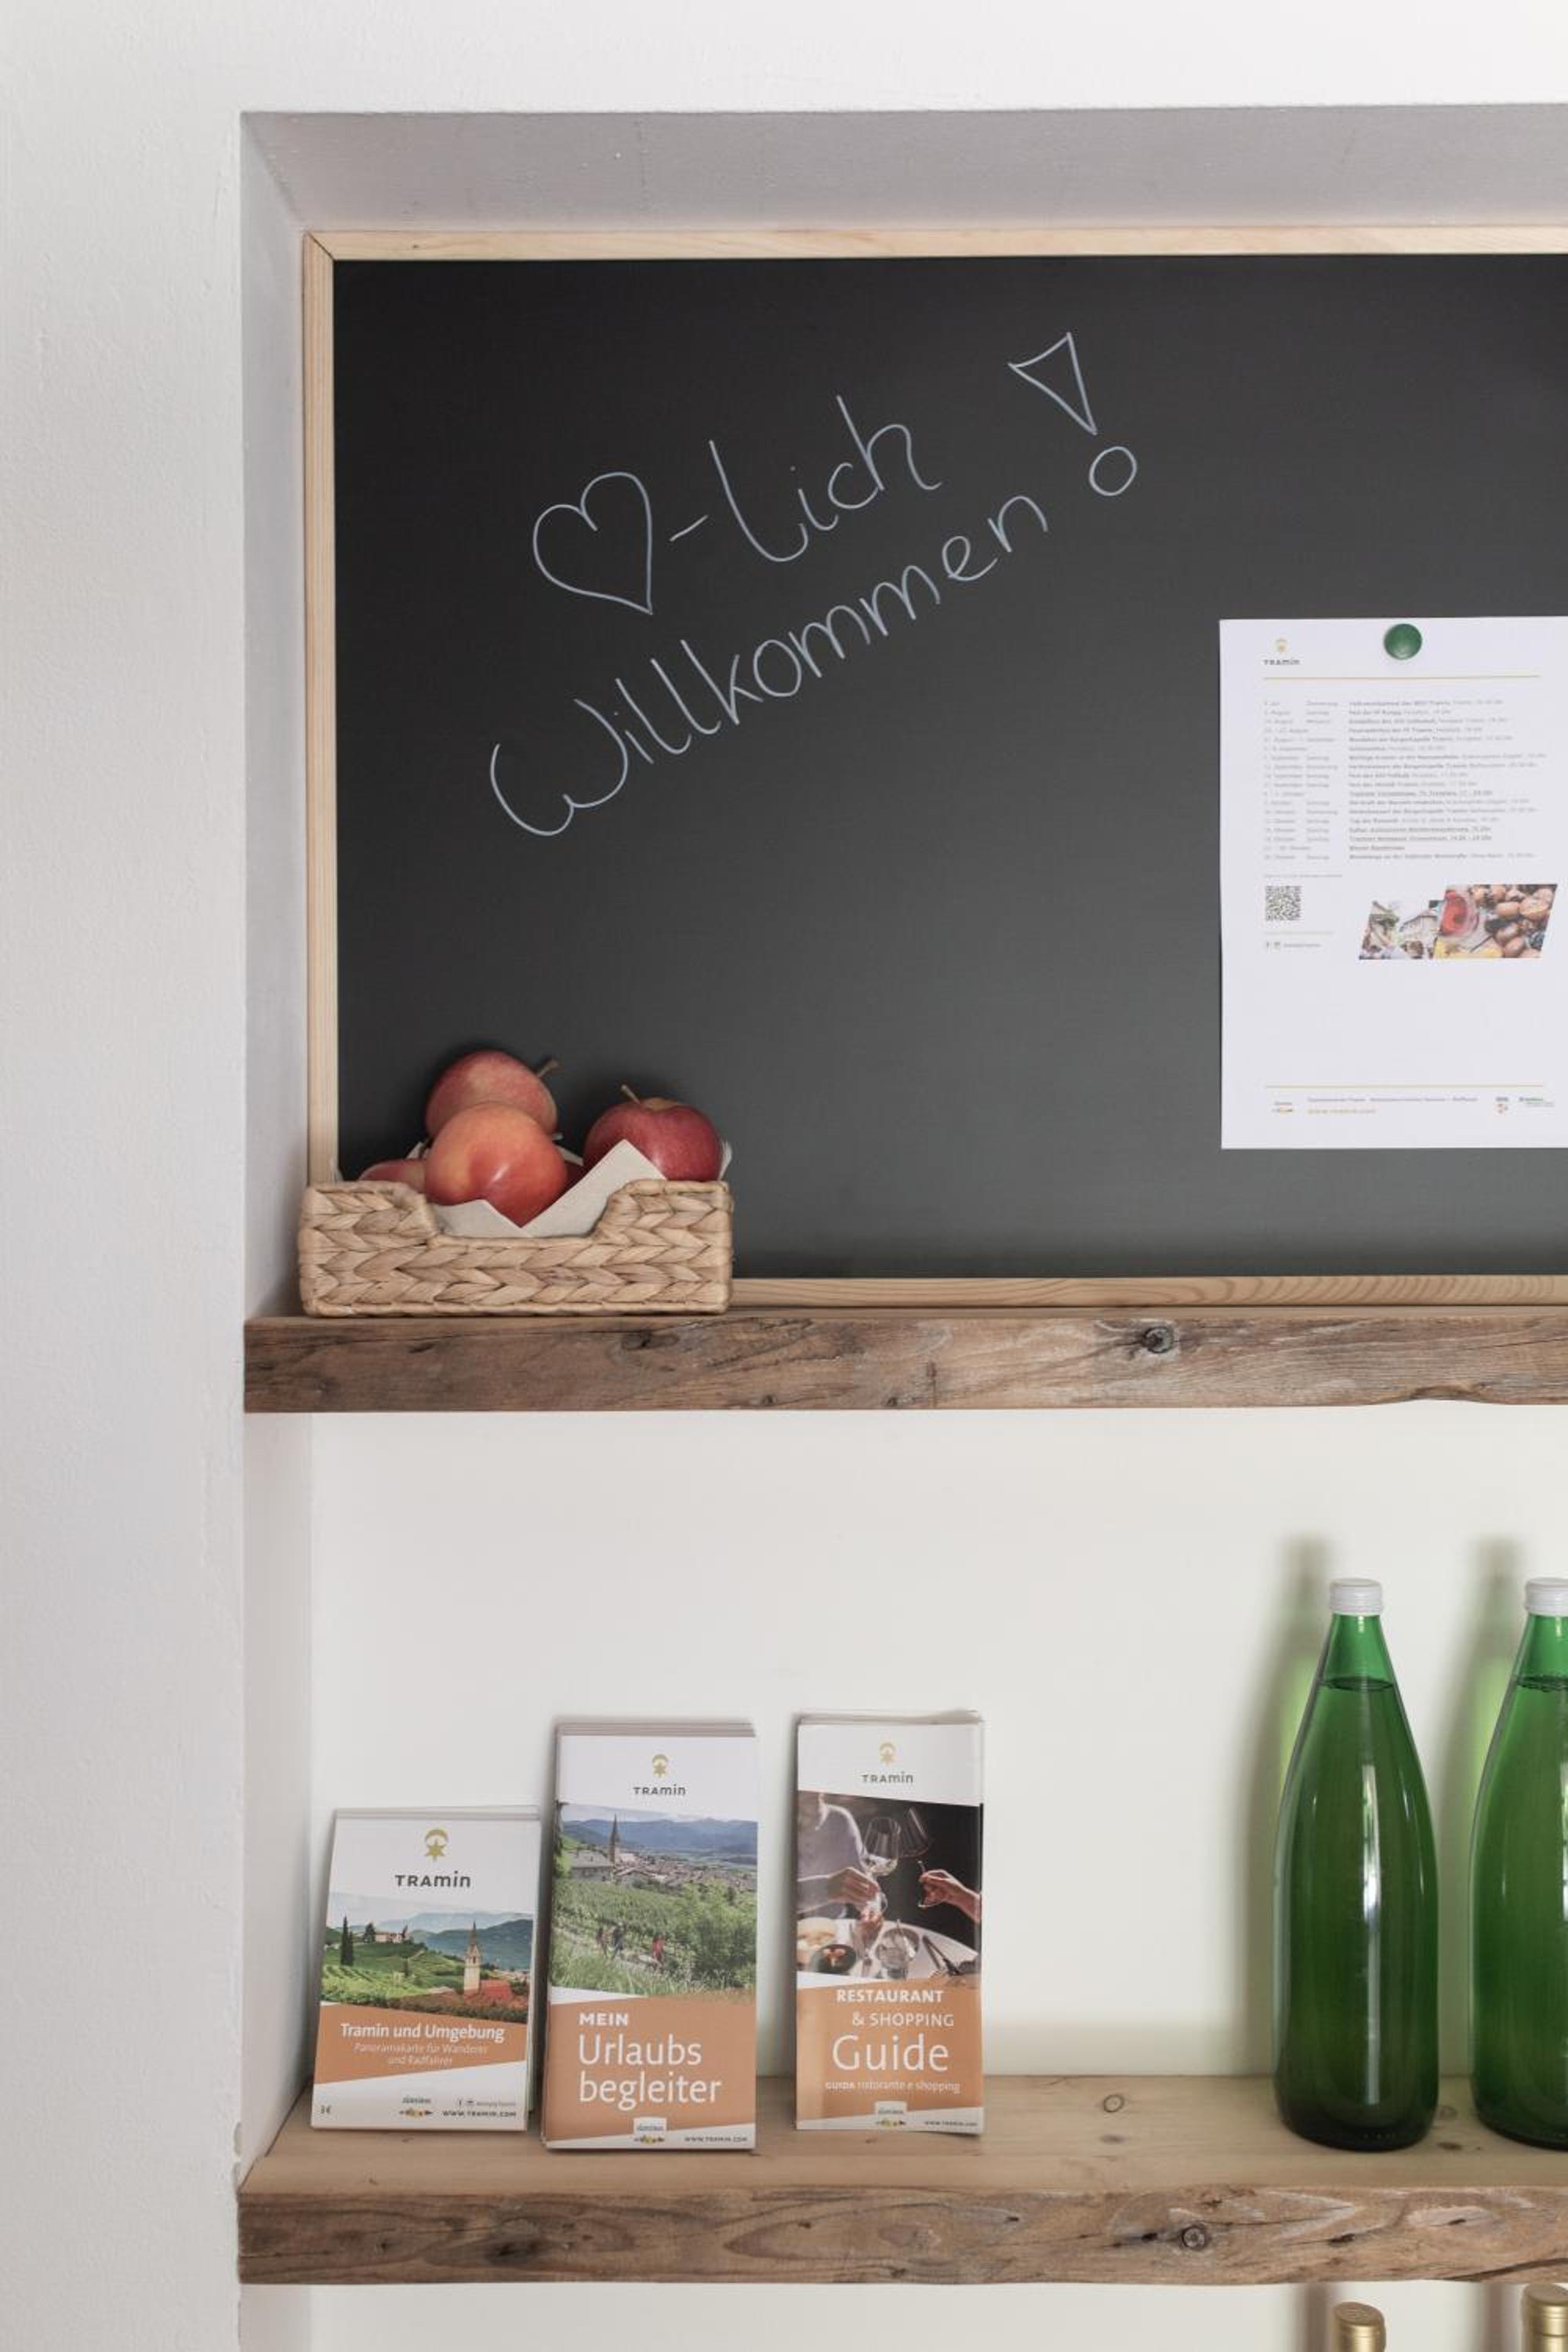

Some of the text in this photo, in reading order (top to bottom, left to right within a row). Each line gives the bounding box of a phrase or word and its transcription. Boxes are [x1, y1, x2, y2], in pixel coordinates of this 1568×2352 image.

[837, 1989, 943, 2003] RESTAURANT
[579, 2013, 628, 2026] MEIN
[853, 2013, 954, 2027] & SHOPPING
[340, 2023, 505, 2044] Tramin und Umgebung
[426, 2042, 440, 2053] für
[579, 2033, 702, 2065] Urlaubs
[833, 2033, 949, 2071] Guide
[579, 2071, 722, 2111] begleiter
[916, 2081, 960, 2094] shopping
